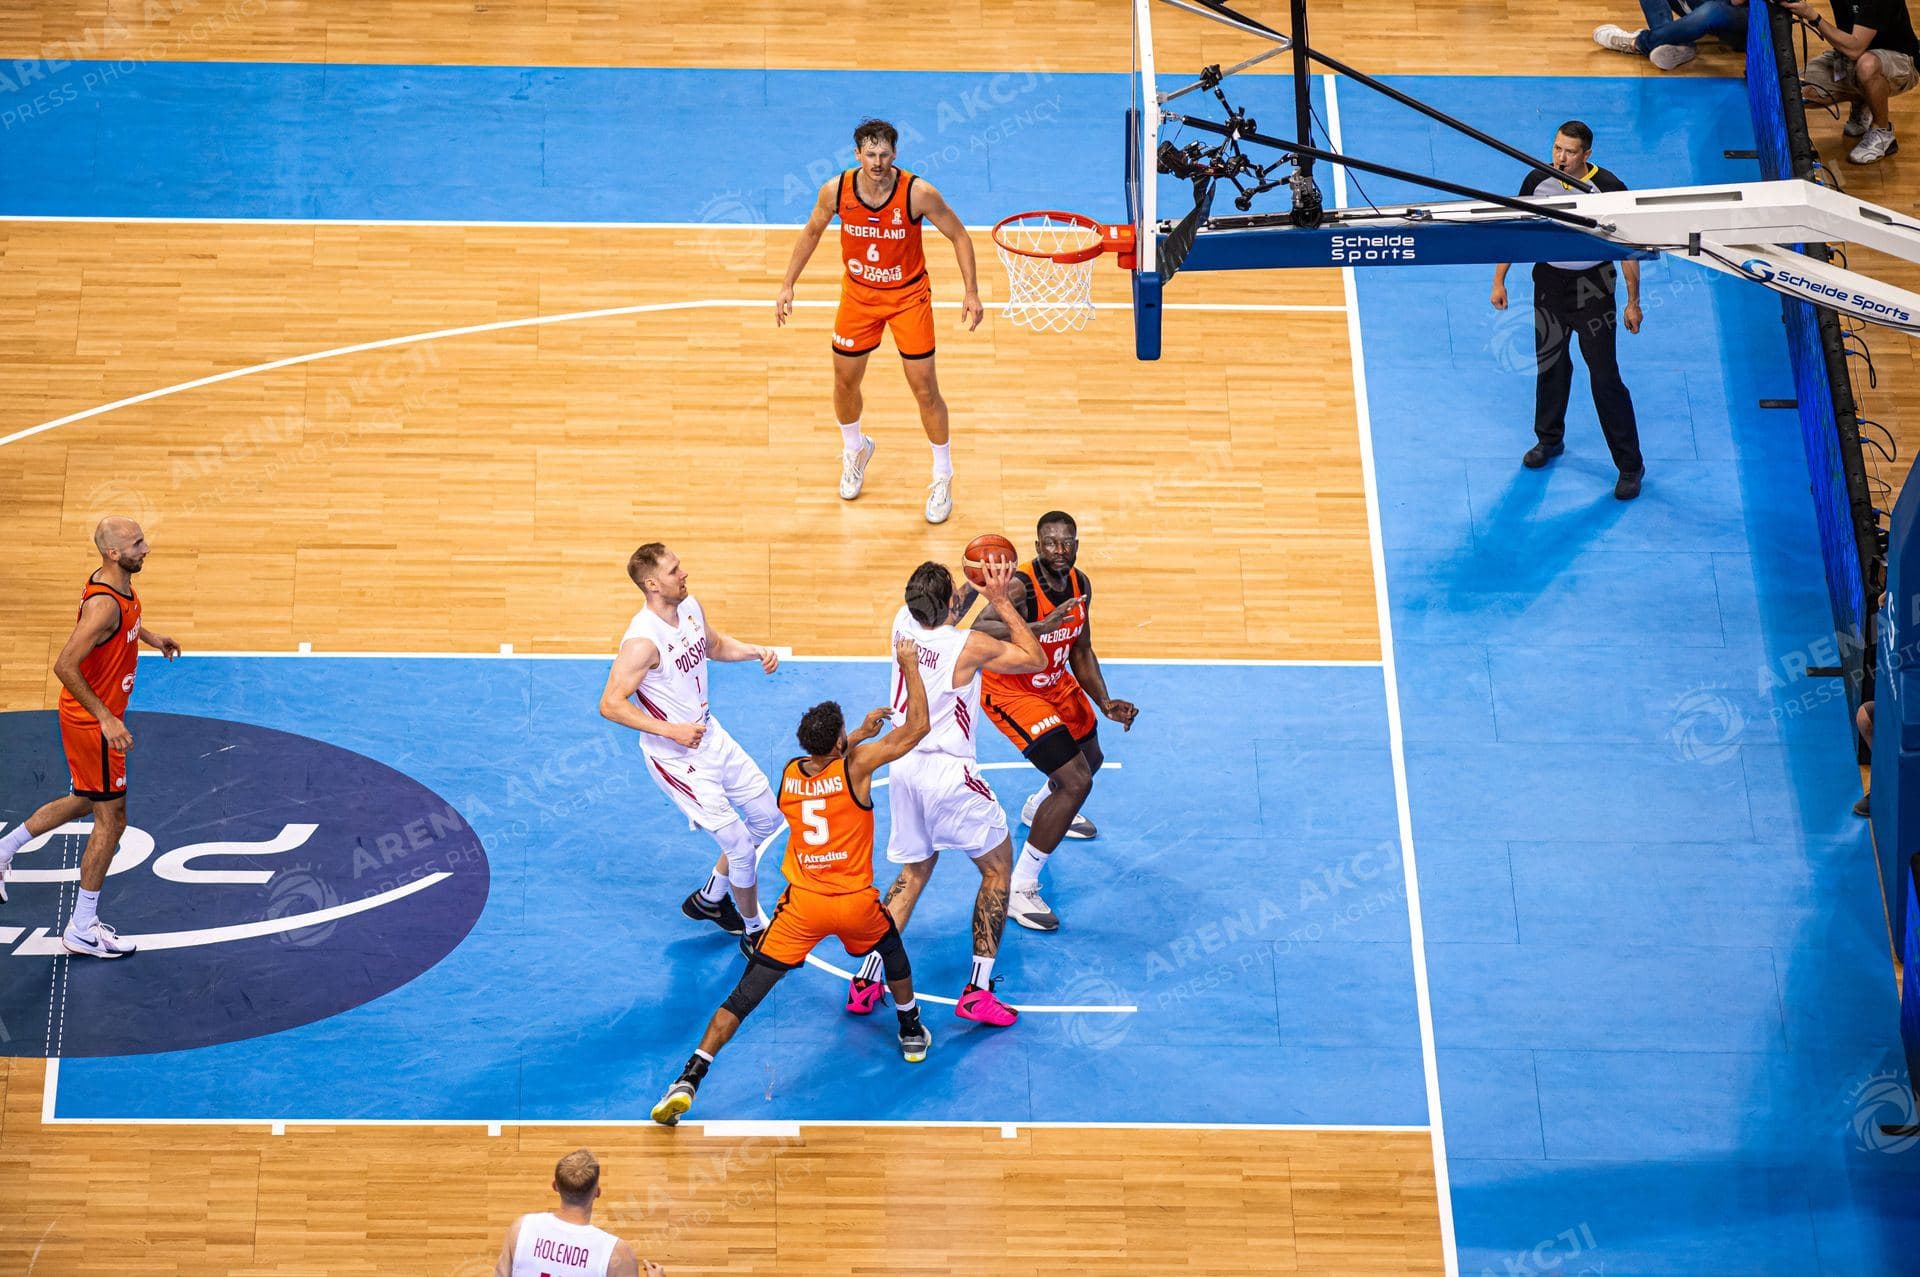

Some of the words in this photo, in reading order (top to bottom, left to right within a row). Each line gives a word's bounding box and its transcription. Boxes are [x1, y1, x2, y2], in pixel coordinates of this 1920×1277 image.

[844, 223, 906, 240] NEDERLAND
[1331, 235, 1415, 248] Schelde
[866, 243, 880, 262] 6
[1331, 248, 1416, 263] Sports
[1777, 270, 1849, 302] Schelde
[1851, 294, 1911, 322] Sports
[695, 676, 701, 694] 1
[784, 776, 843, 796] WILLIAMS
[801, 798, 830, 846] 5
[804, 851, 848, 864] Atradius
[533, 1237, 590, 1269] KOLENDA
